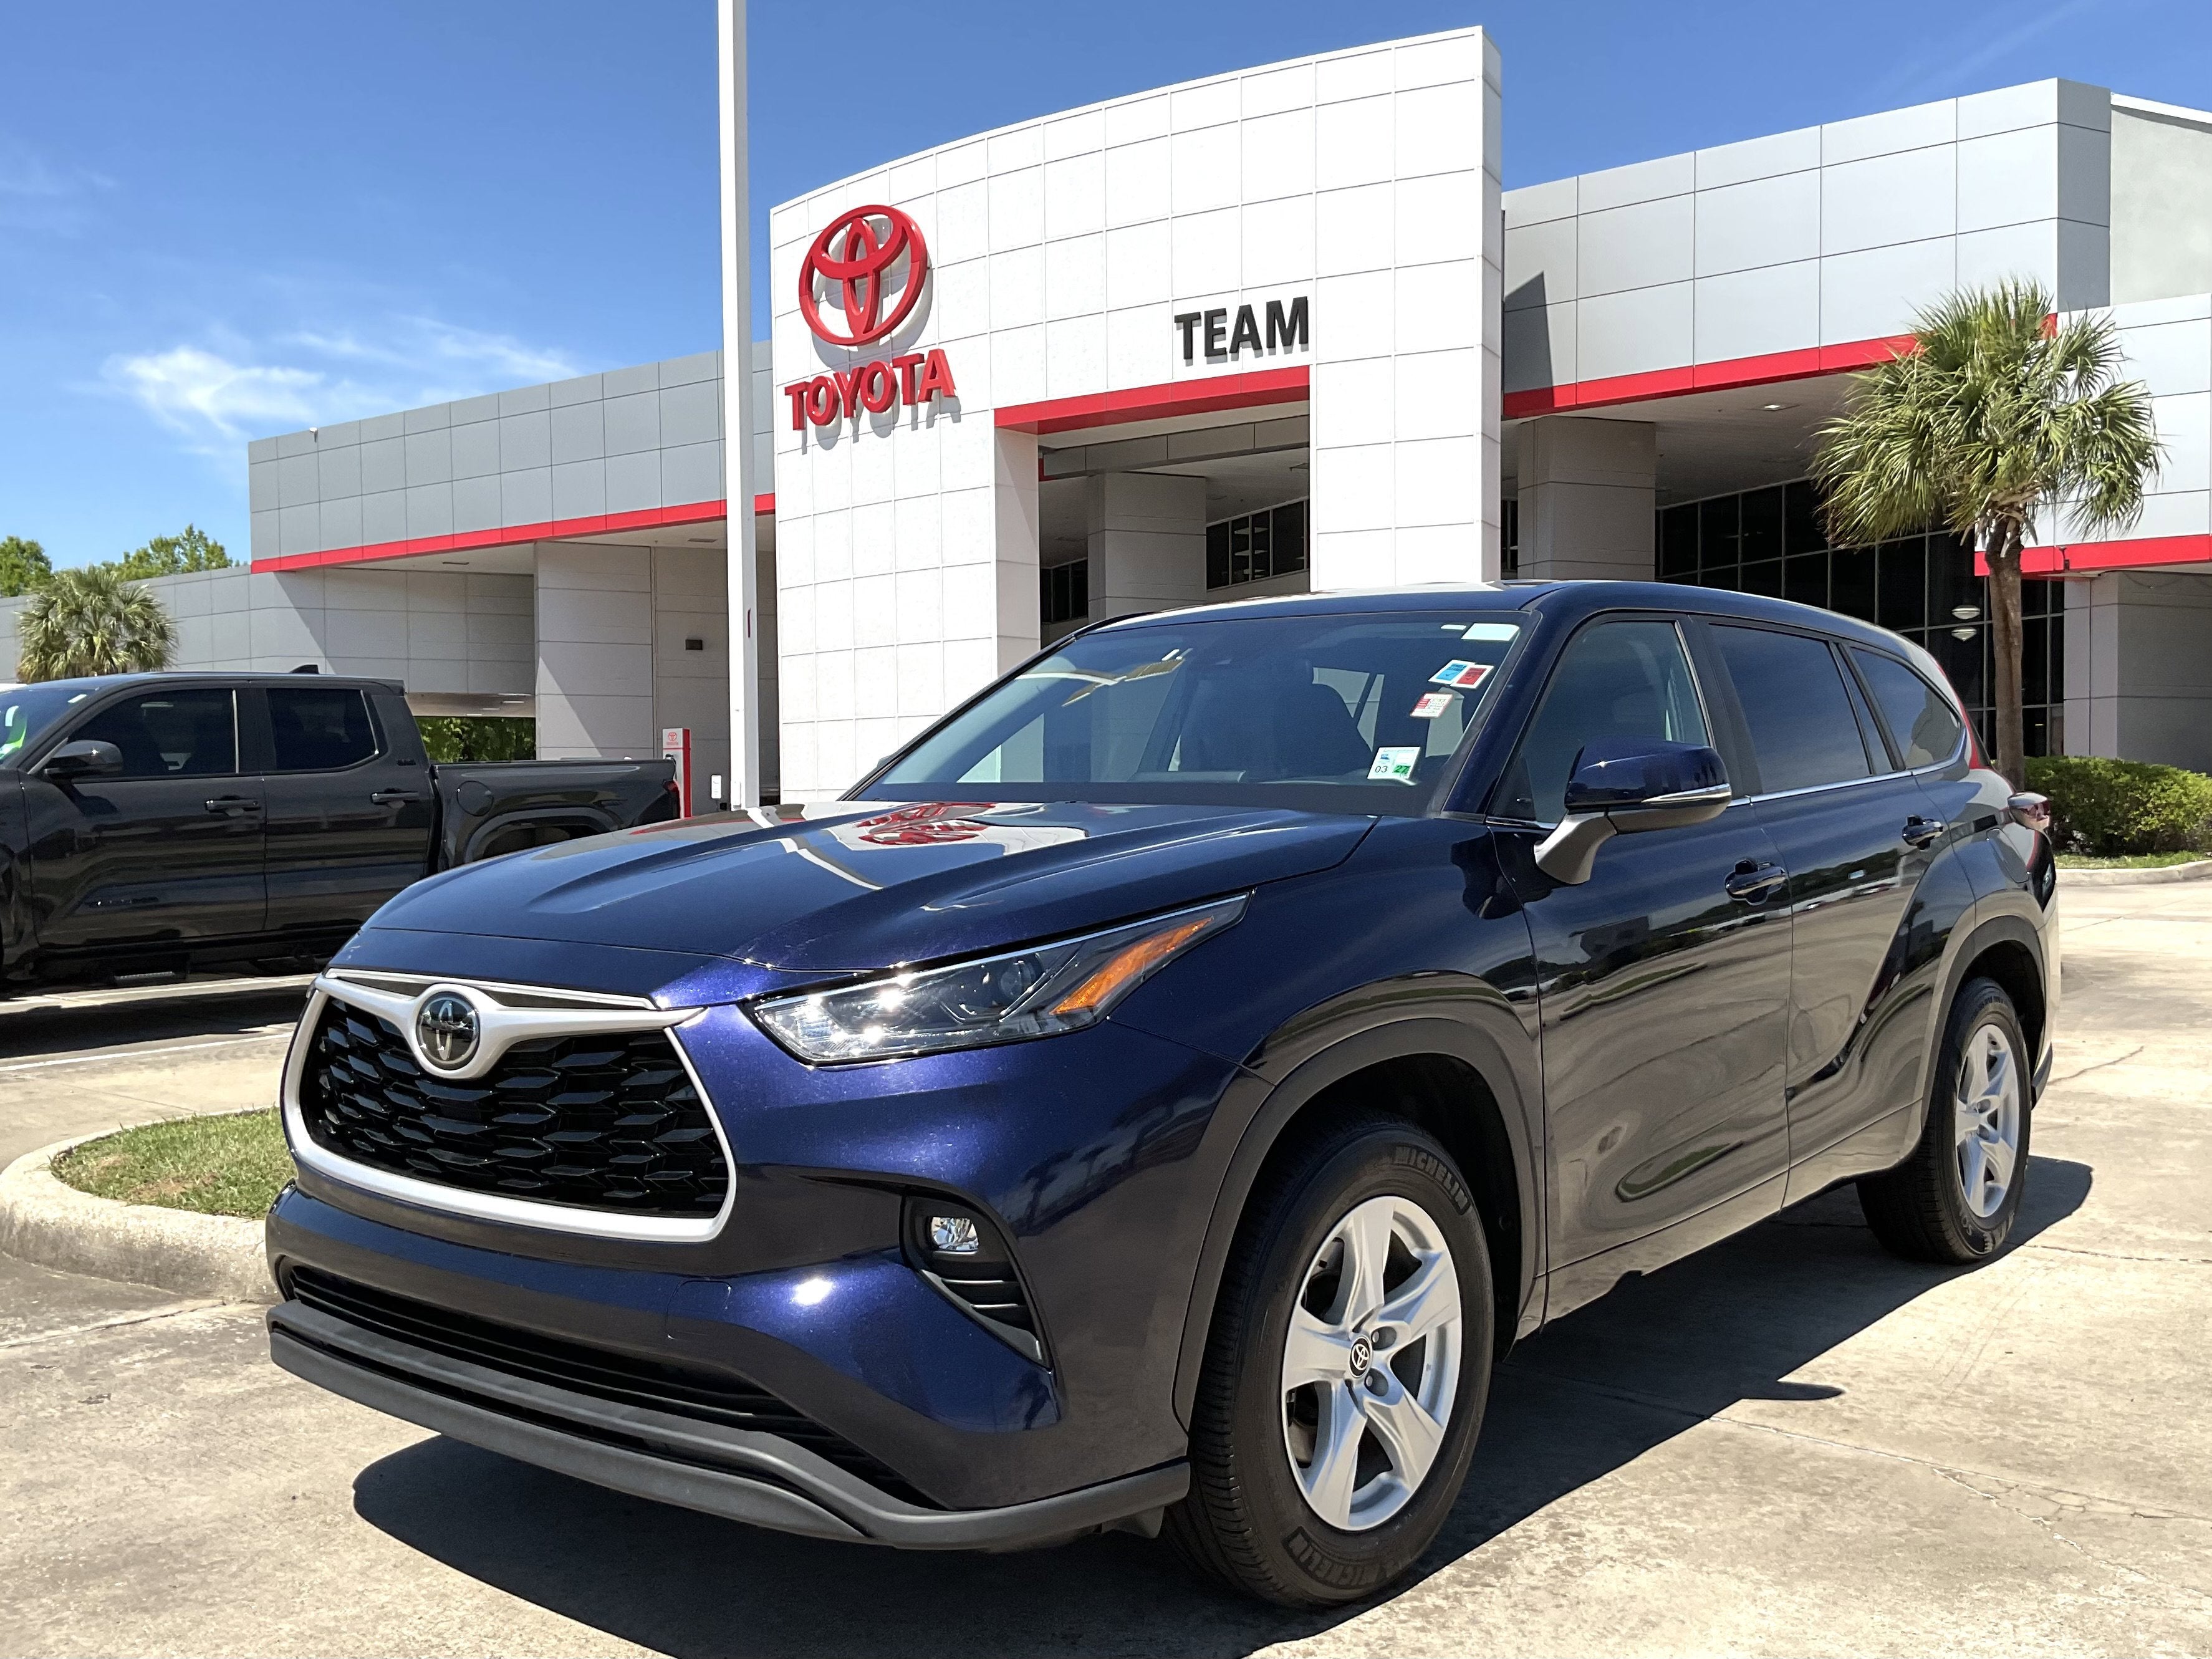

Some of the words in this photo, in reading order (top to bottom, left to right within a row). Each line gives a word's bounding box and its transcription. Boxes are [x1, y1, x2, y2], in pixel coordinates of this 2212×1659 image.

[1175, 296, 1309, 360] TEAM
[784, 348, 957, 431] TOYOTA
[1394, 765, 1411, 774] 27
[1393, 1145, 1469, 1211] MICHELIN
